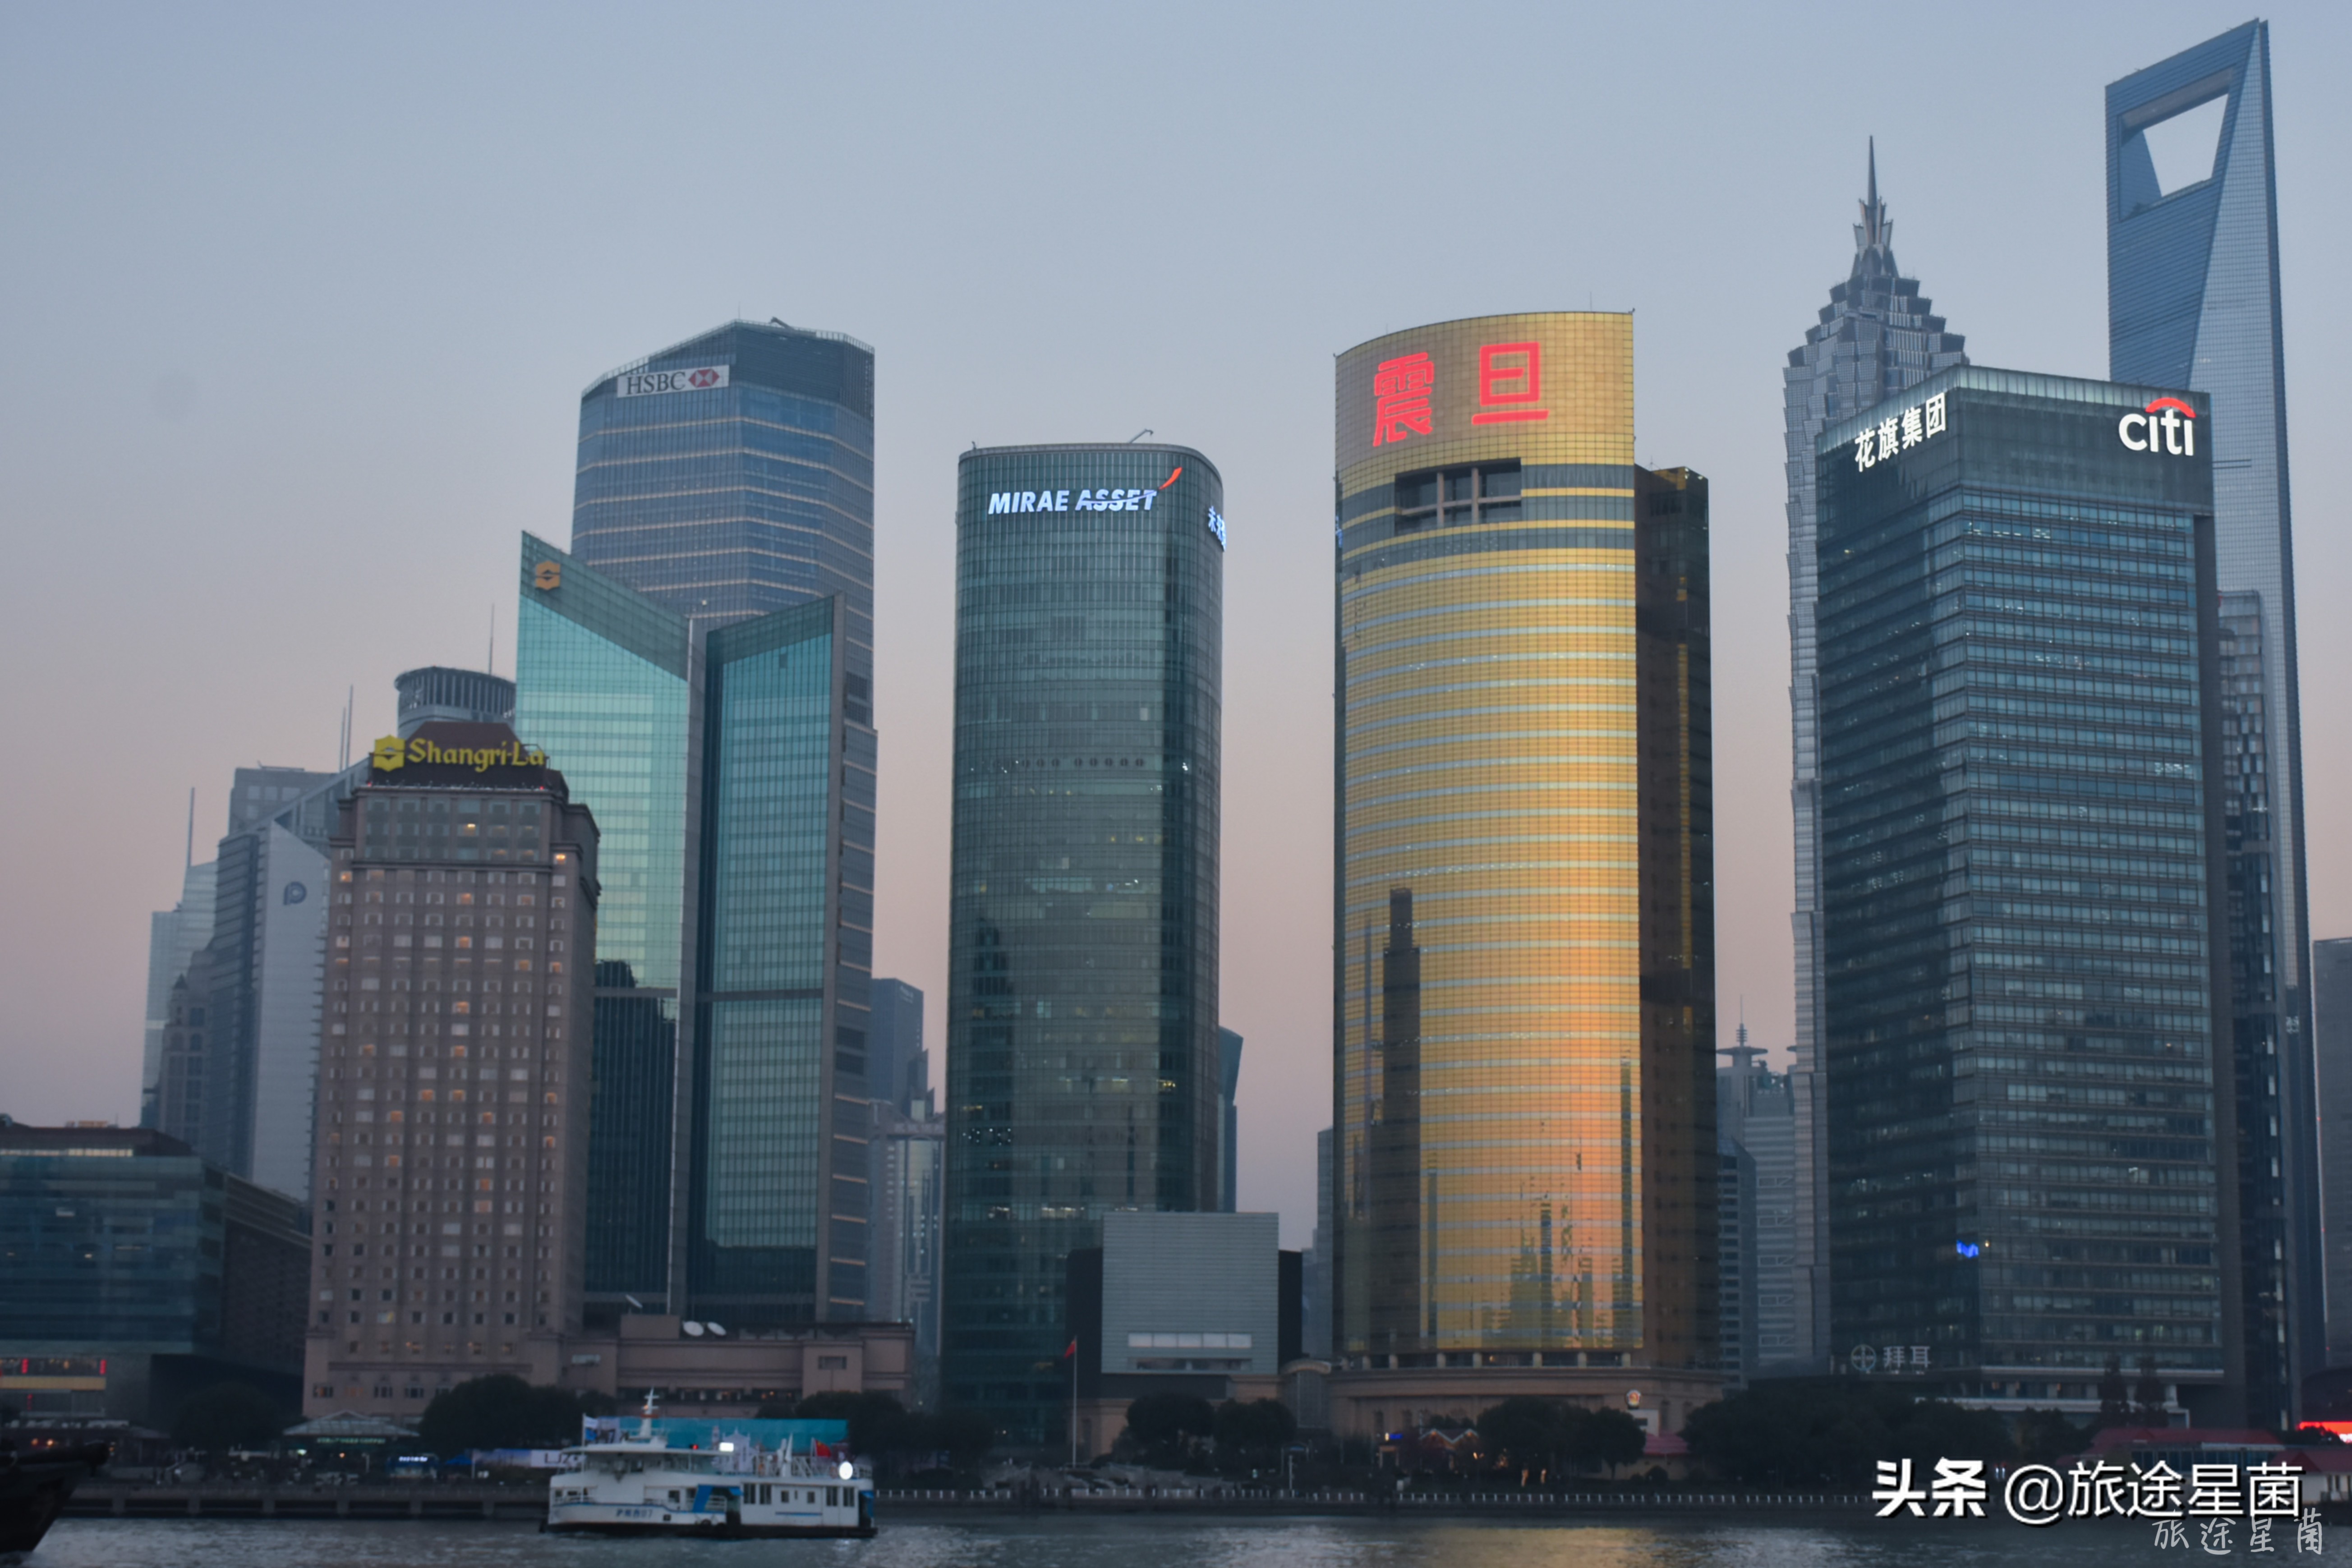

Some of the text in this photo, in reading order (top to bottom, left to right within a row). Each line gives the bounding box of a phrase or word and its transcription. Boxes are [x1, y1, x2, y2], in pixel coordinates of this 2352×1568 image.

[626, 372, 686, 395] HSBC
[1372, 341, 1550, 447] 震旦
[1855, 391, 1947, 472] 花旗集团
[2118, 408, 2194, 456] citi
[988, 489, 1157, 515] MIRAE ASSET
[408, 738, 544, 773] Shangri-La
[1883, 1346, 1931, 1369] 拜耳
